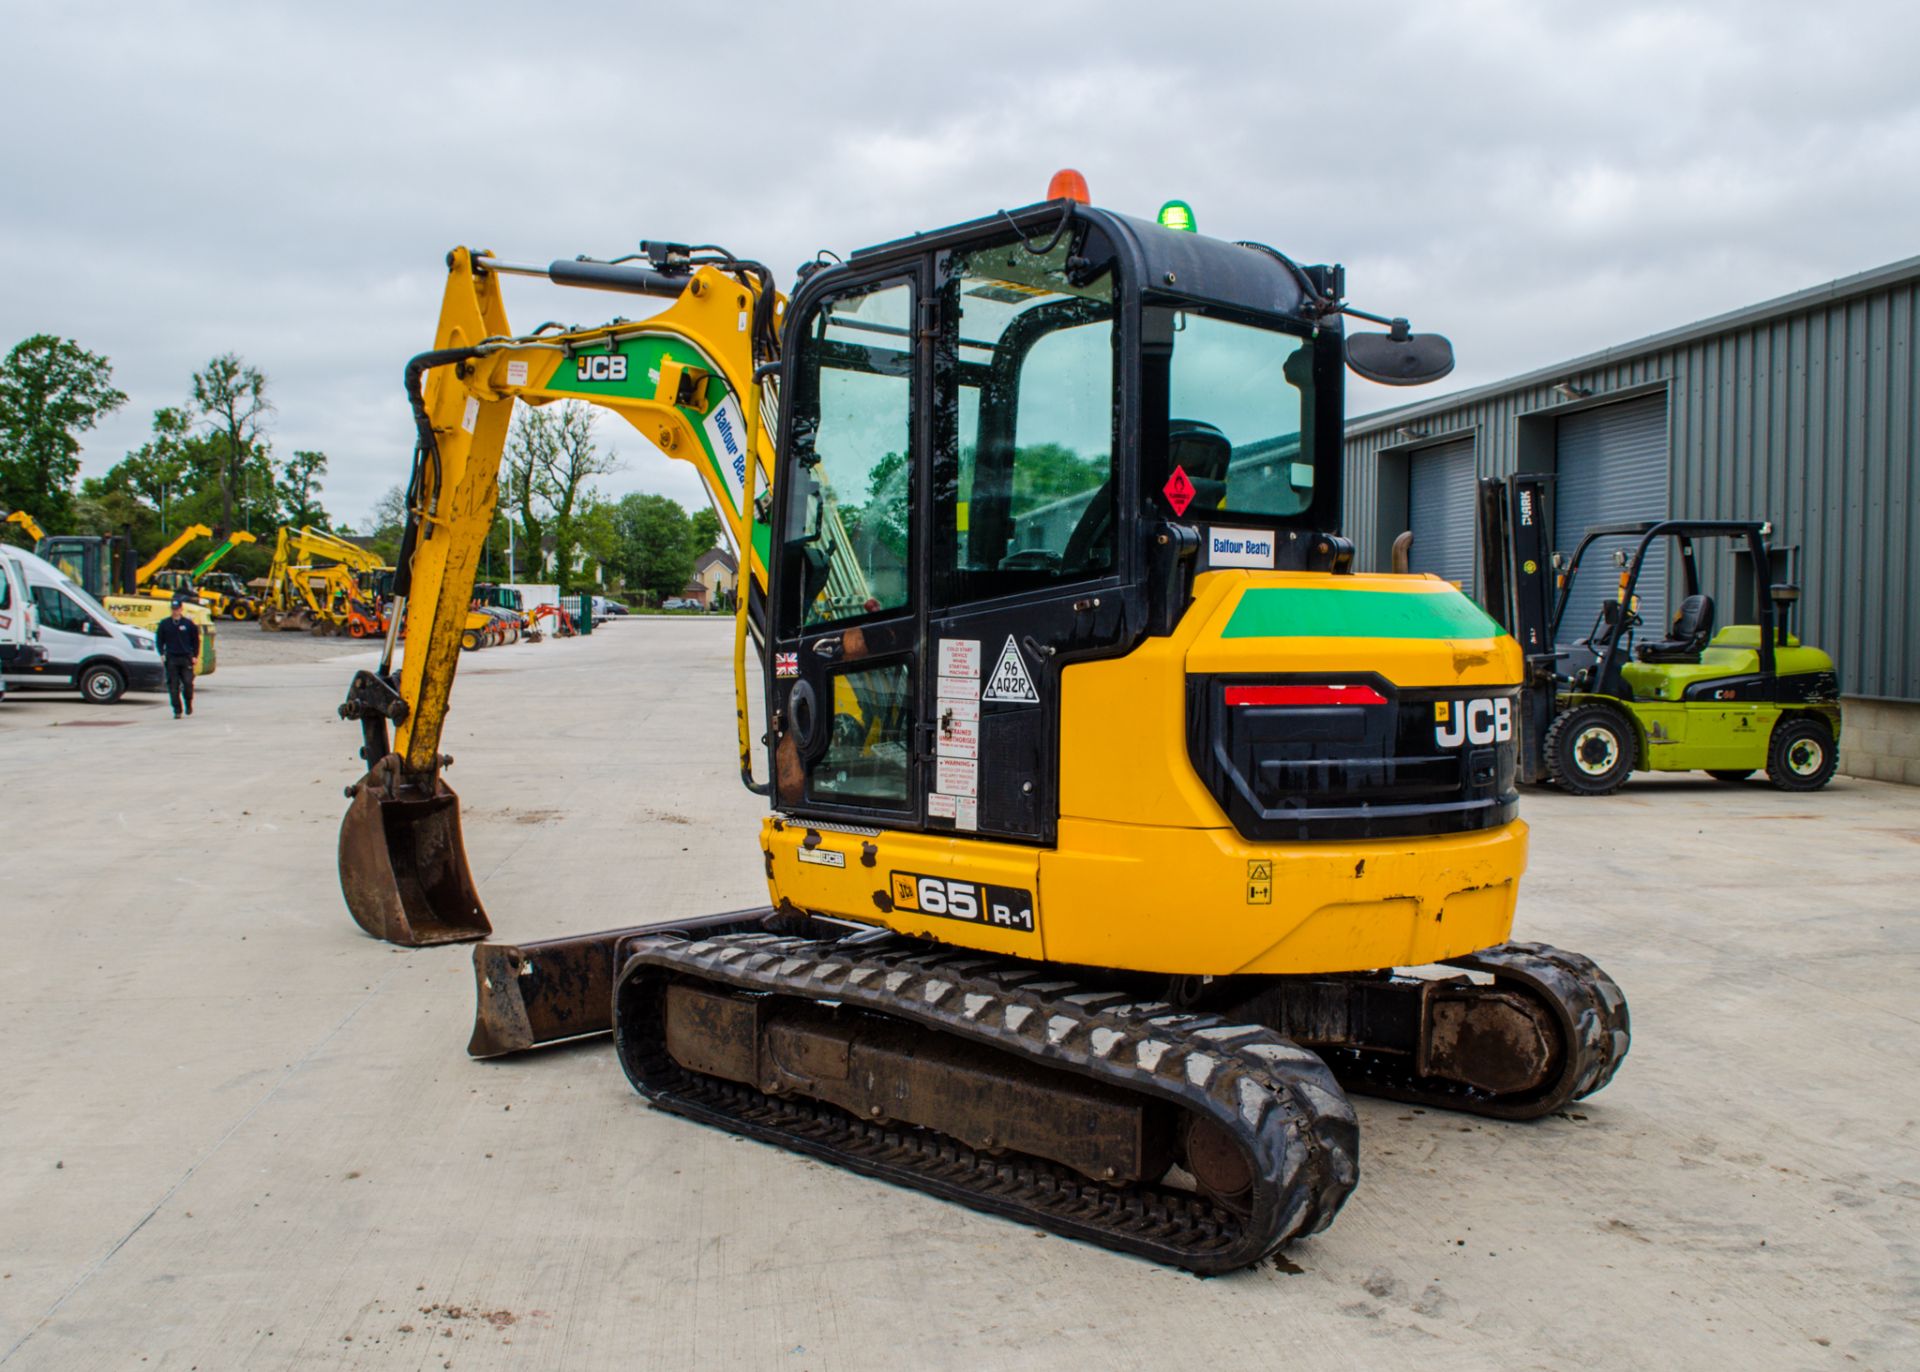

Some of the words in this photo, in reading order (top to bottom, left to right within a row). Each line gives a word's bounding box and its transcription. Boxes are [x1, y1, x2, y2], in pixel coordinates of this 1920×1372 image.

[578, 356, 627, 380] JCB
[714, 407, 738, 455] Balfour
[732, 453, 746, 489] Bea
[1520, 491, 1533, 526] CLARK
[1213, 538, 1244, 554] Balfour
[1245, 540, 1271, 558] Beatty
[108, 604, 152, 612] HYSTER
[1004, 661, 1018, 677] 96
[996, 677, 1026, 694] AQ2R
[1435, 698, 1512, 748] JCB
[943, 759, 971, 767] WARNING
[899, 882, 913, 898] JCB
[918, 878, 978, 919] 65
[993, 904, 1032, 929] R-1
